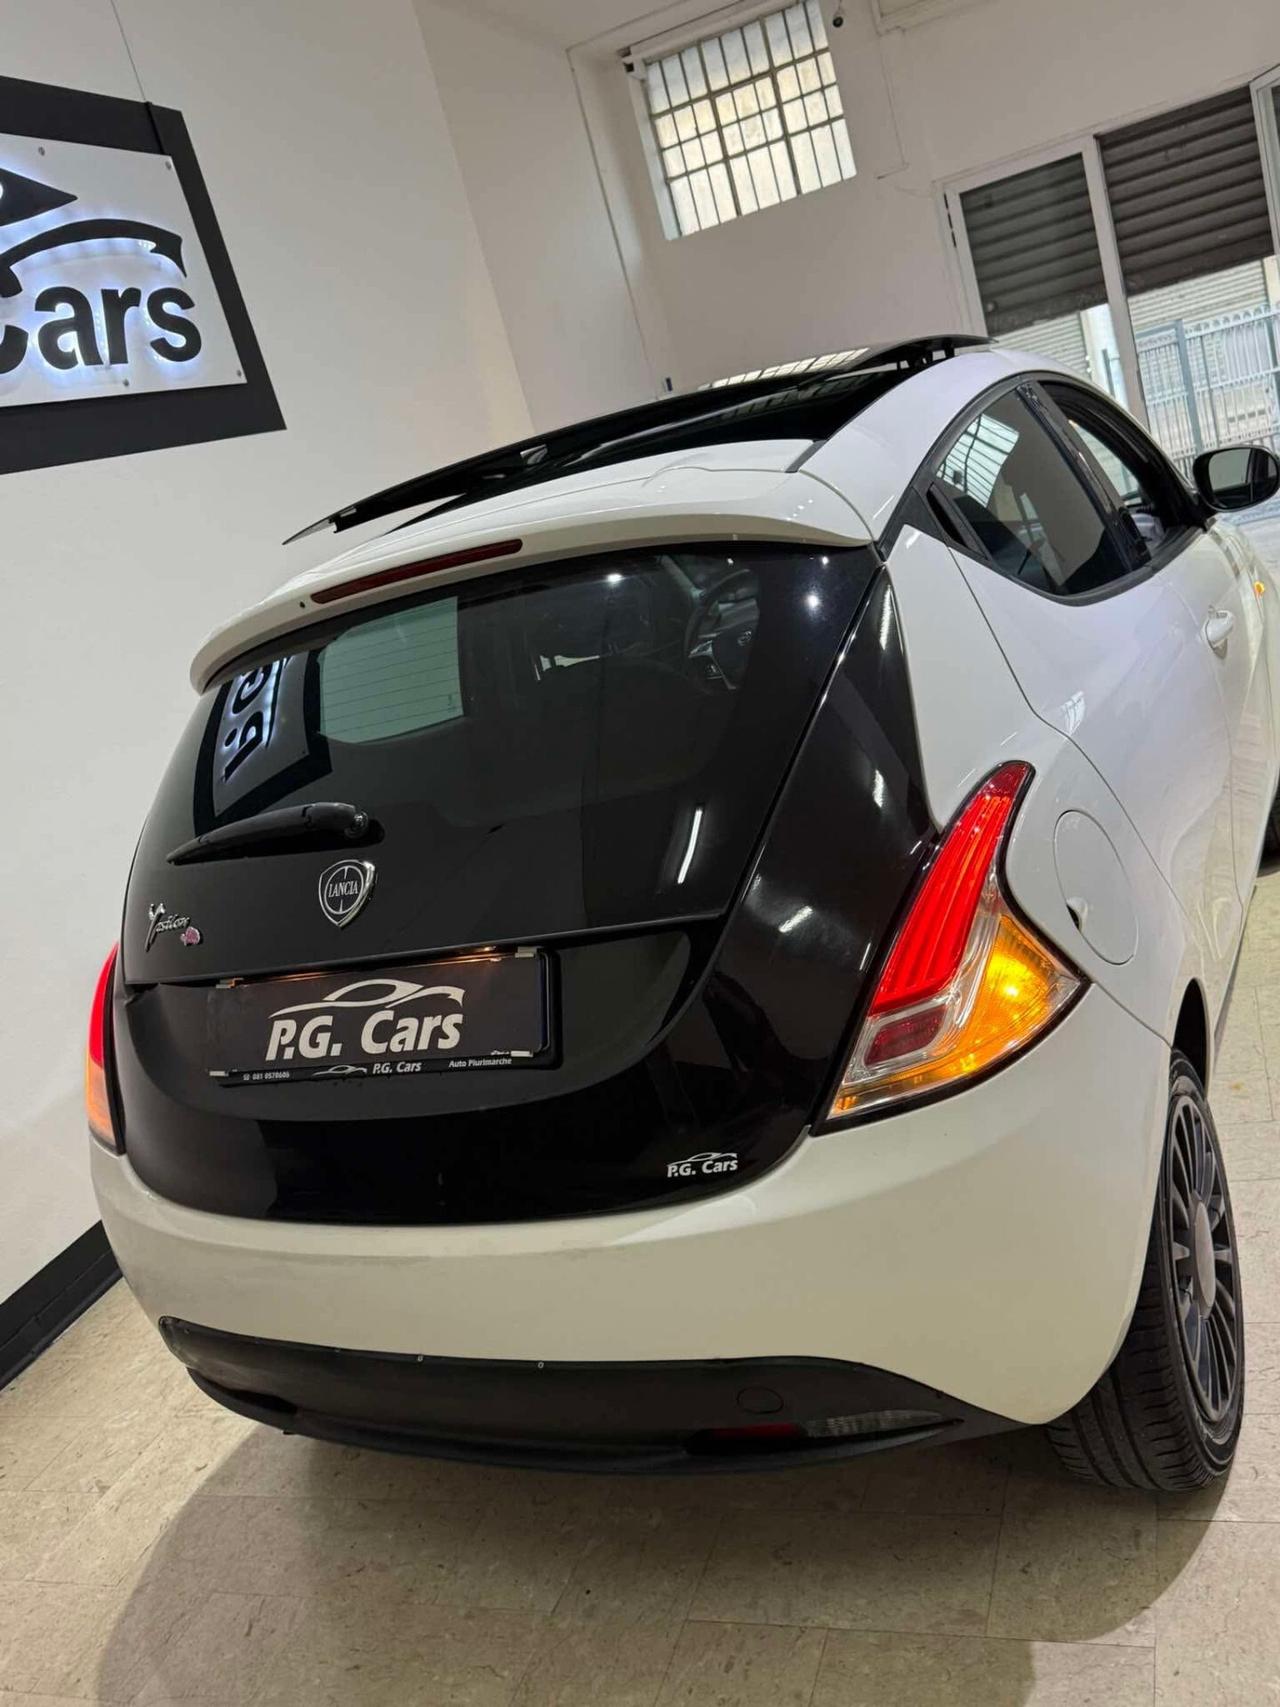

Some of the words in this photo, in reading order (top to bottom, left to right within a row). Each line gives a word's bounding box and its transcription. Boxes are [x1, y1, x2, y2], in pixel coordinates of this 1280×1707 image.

[328, 880, 359, 898] LANCIA
[265, 1015, 343, 1061] P.G.
[361, 1010, 464, 1055] Cars
[372, 1062, 393, 1075] P.G.
[396, 1061, 423, 1073] Cars
[448, 1060, 467, 1068] Auto
[666, 1163, 696, 1178] P.G.
[701, 1159, 739, 1174] Cars
